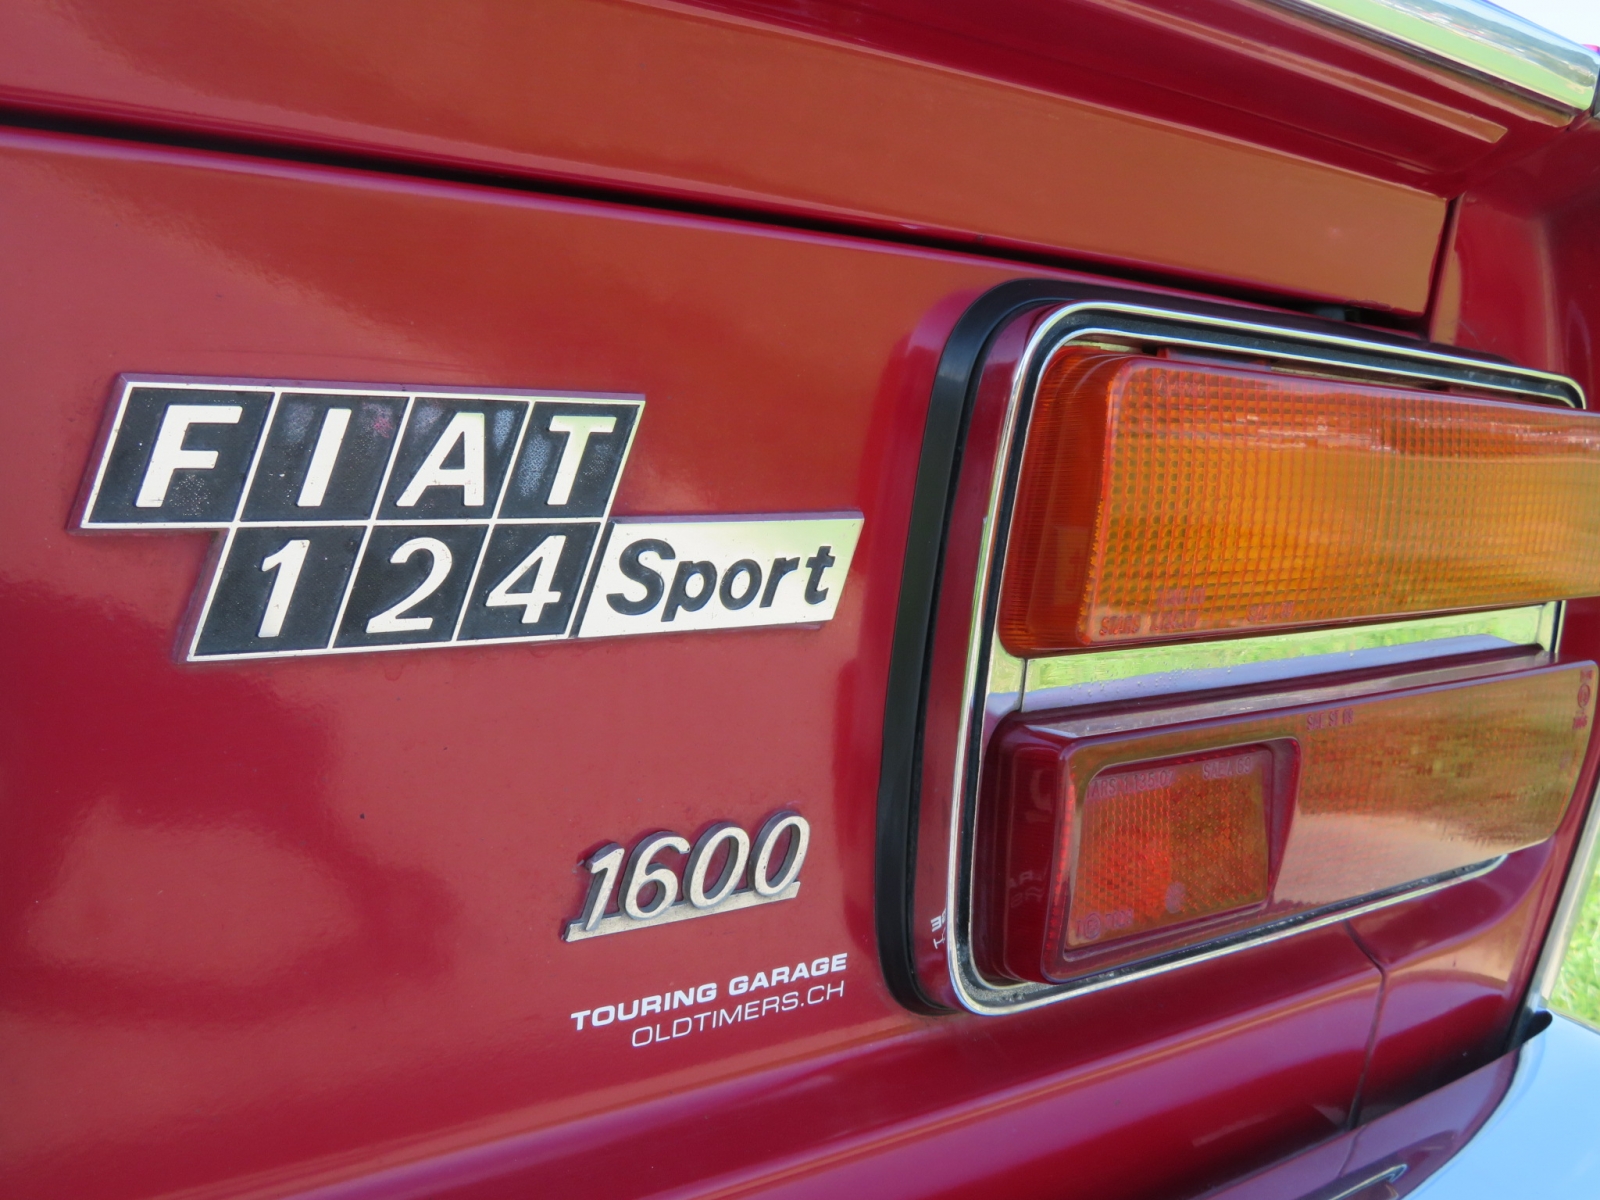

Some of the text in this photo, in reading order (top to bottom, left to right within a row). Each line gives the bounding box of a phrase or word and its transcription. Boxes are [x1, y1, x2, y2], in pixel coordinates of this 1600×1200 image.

[135, 404, 617, 508] FIAT
[257, 533, 835, 638] 124 Sport
[584, 811, 811, 931] 1600
[570, 953, 848, 1031] TOURING GARAGE
[631, 981, 846, 1048] OLDTIMERS.CH
